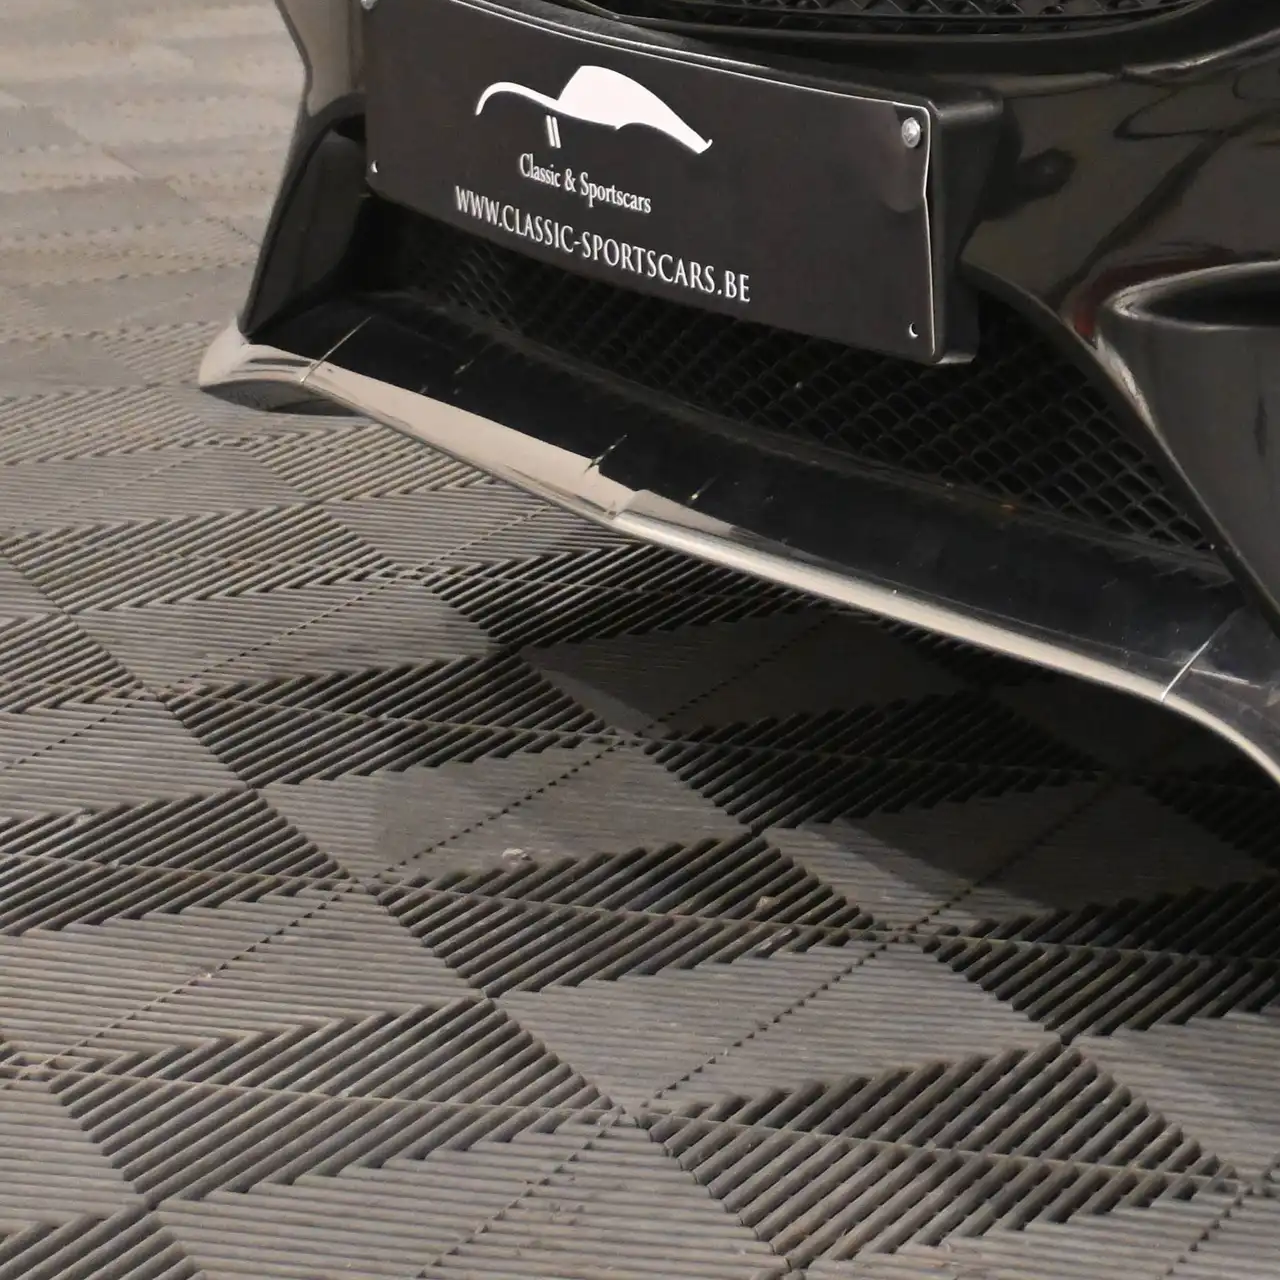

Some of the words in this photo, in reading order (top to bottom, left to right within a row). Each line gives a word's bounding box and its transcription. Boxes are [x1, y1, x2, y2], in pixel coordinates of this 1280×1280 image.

[518, 152, 561, 188] Classic
[564, 168, 577, 193] &
[580, 171, 651, 213] Sportscars
[454, 184, 750, 303] WWW.CLASSIC-SPORTSCARS.BE
